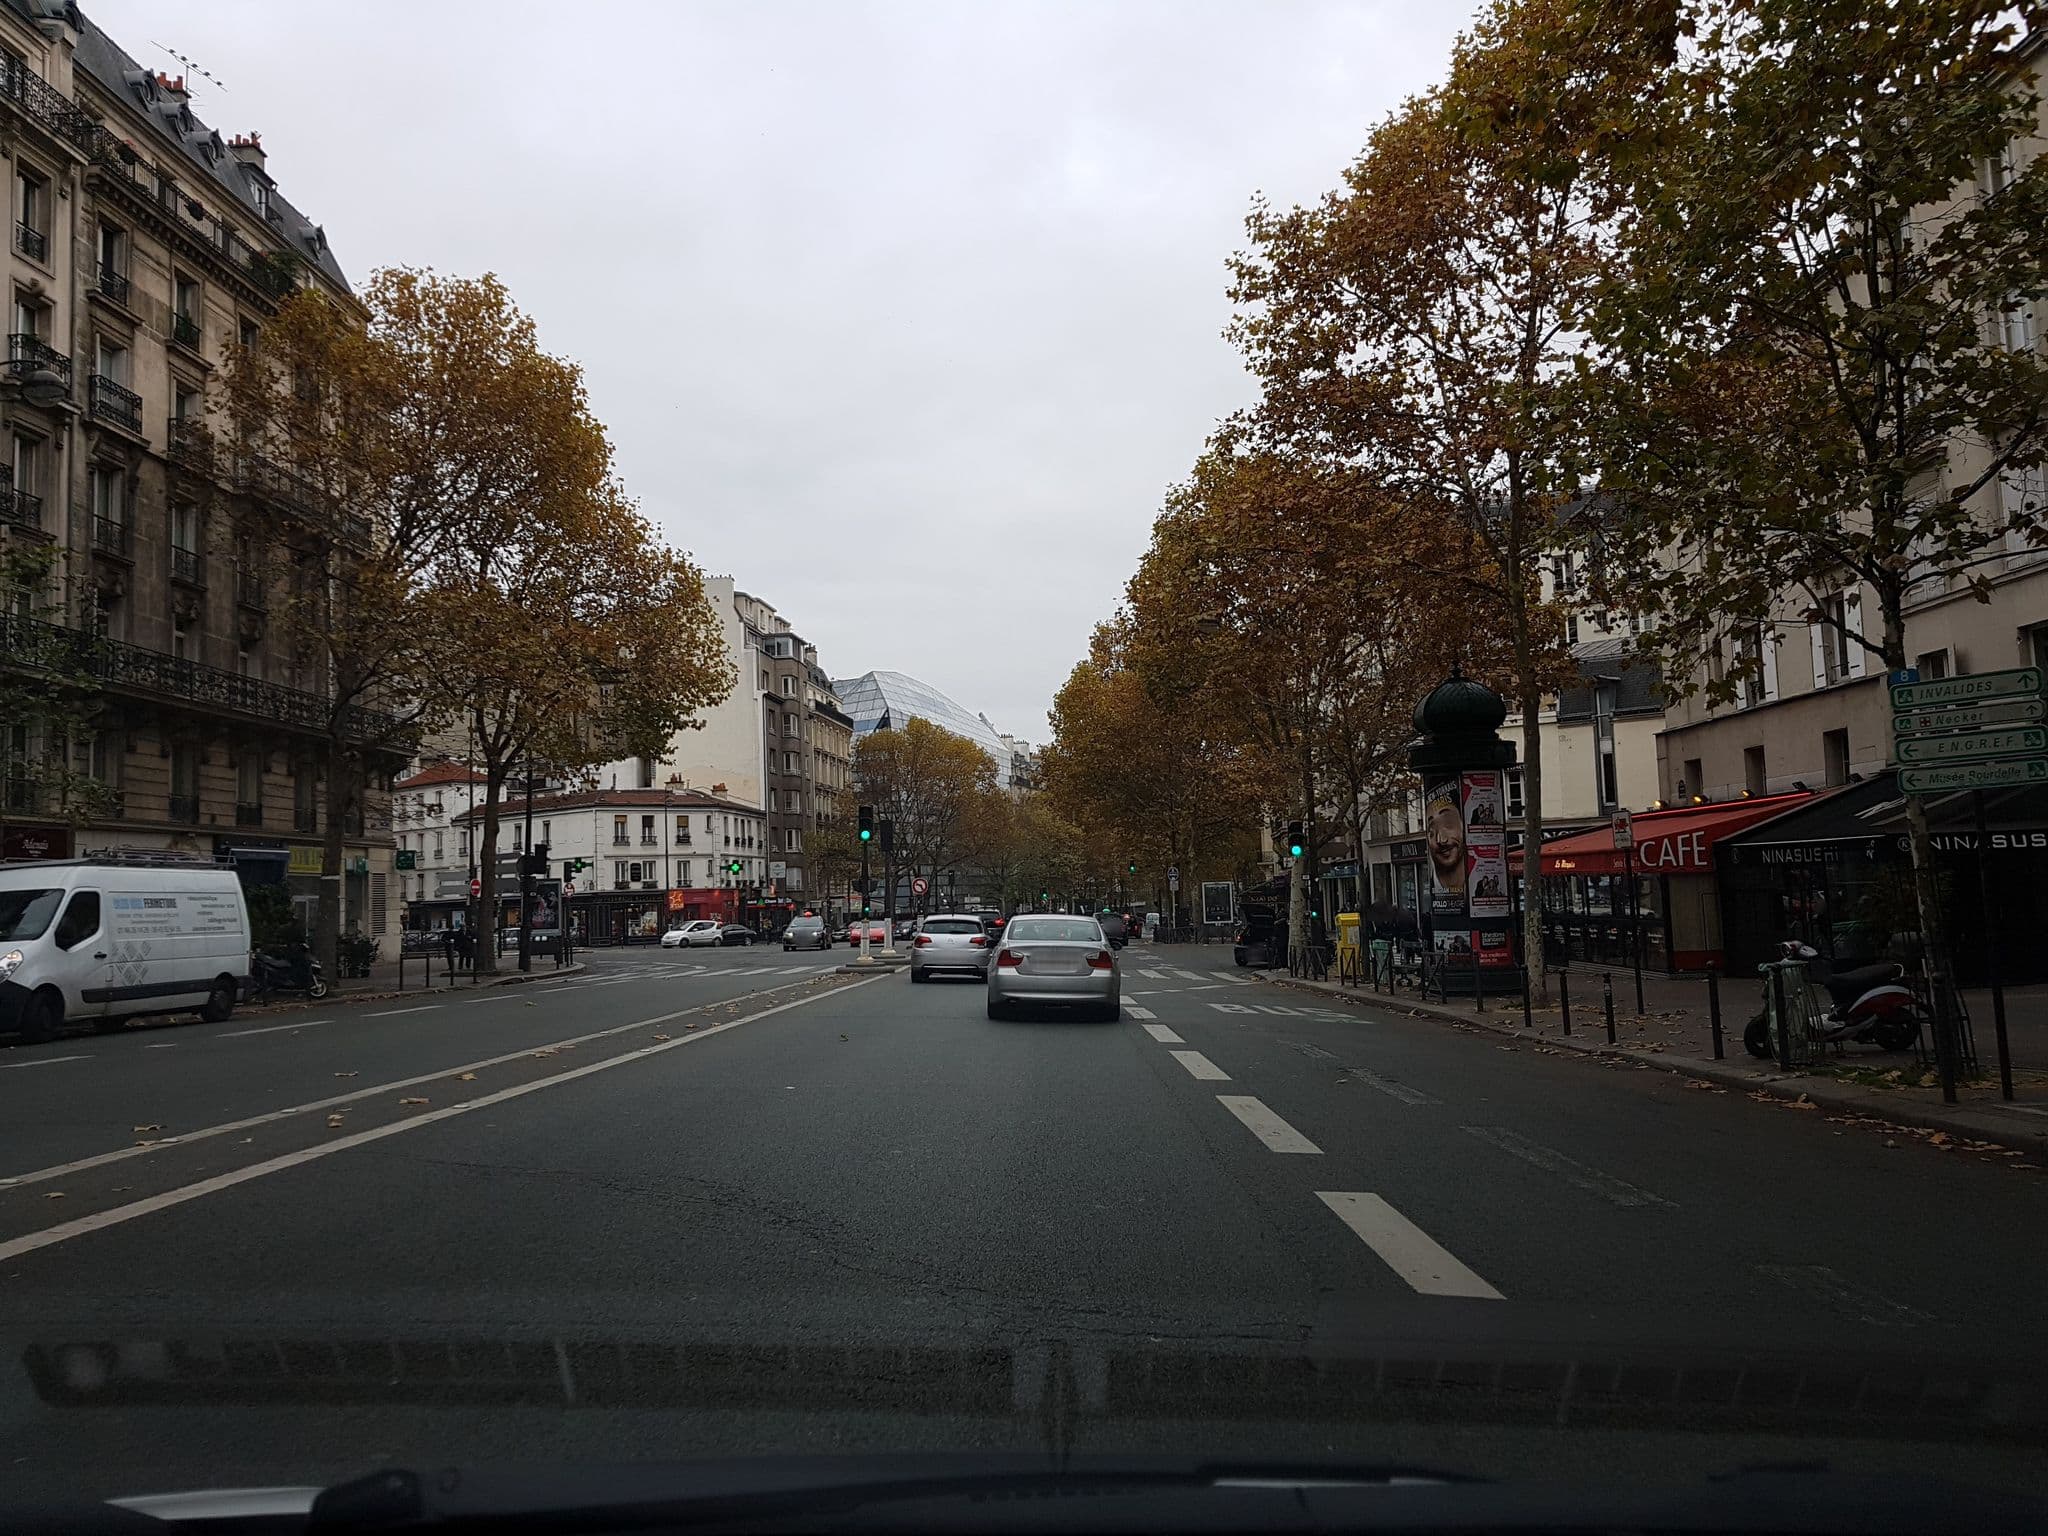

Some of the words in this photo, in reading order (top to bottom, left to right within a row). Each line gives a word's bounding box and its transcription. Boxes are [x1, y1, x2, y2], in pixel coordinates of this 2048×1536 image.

[1900, 670, 1909, 681] 8
[1920, 681, 1993, 700] INVALIDES
[1935, 712, 1984, 725] Necker
[1929, 772, 1966, 785] Musée
[1639, 831, 1708, 868] CAFE
[1761, 846, 1840, 864] NINASUSHI
[1206, 1002, 1376, 1025] BUS
